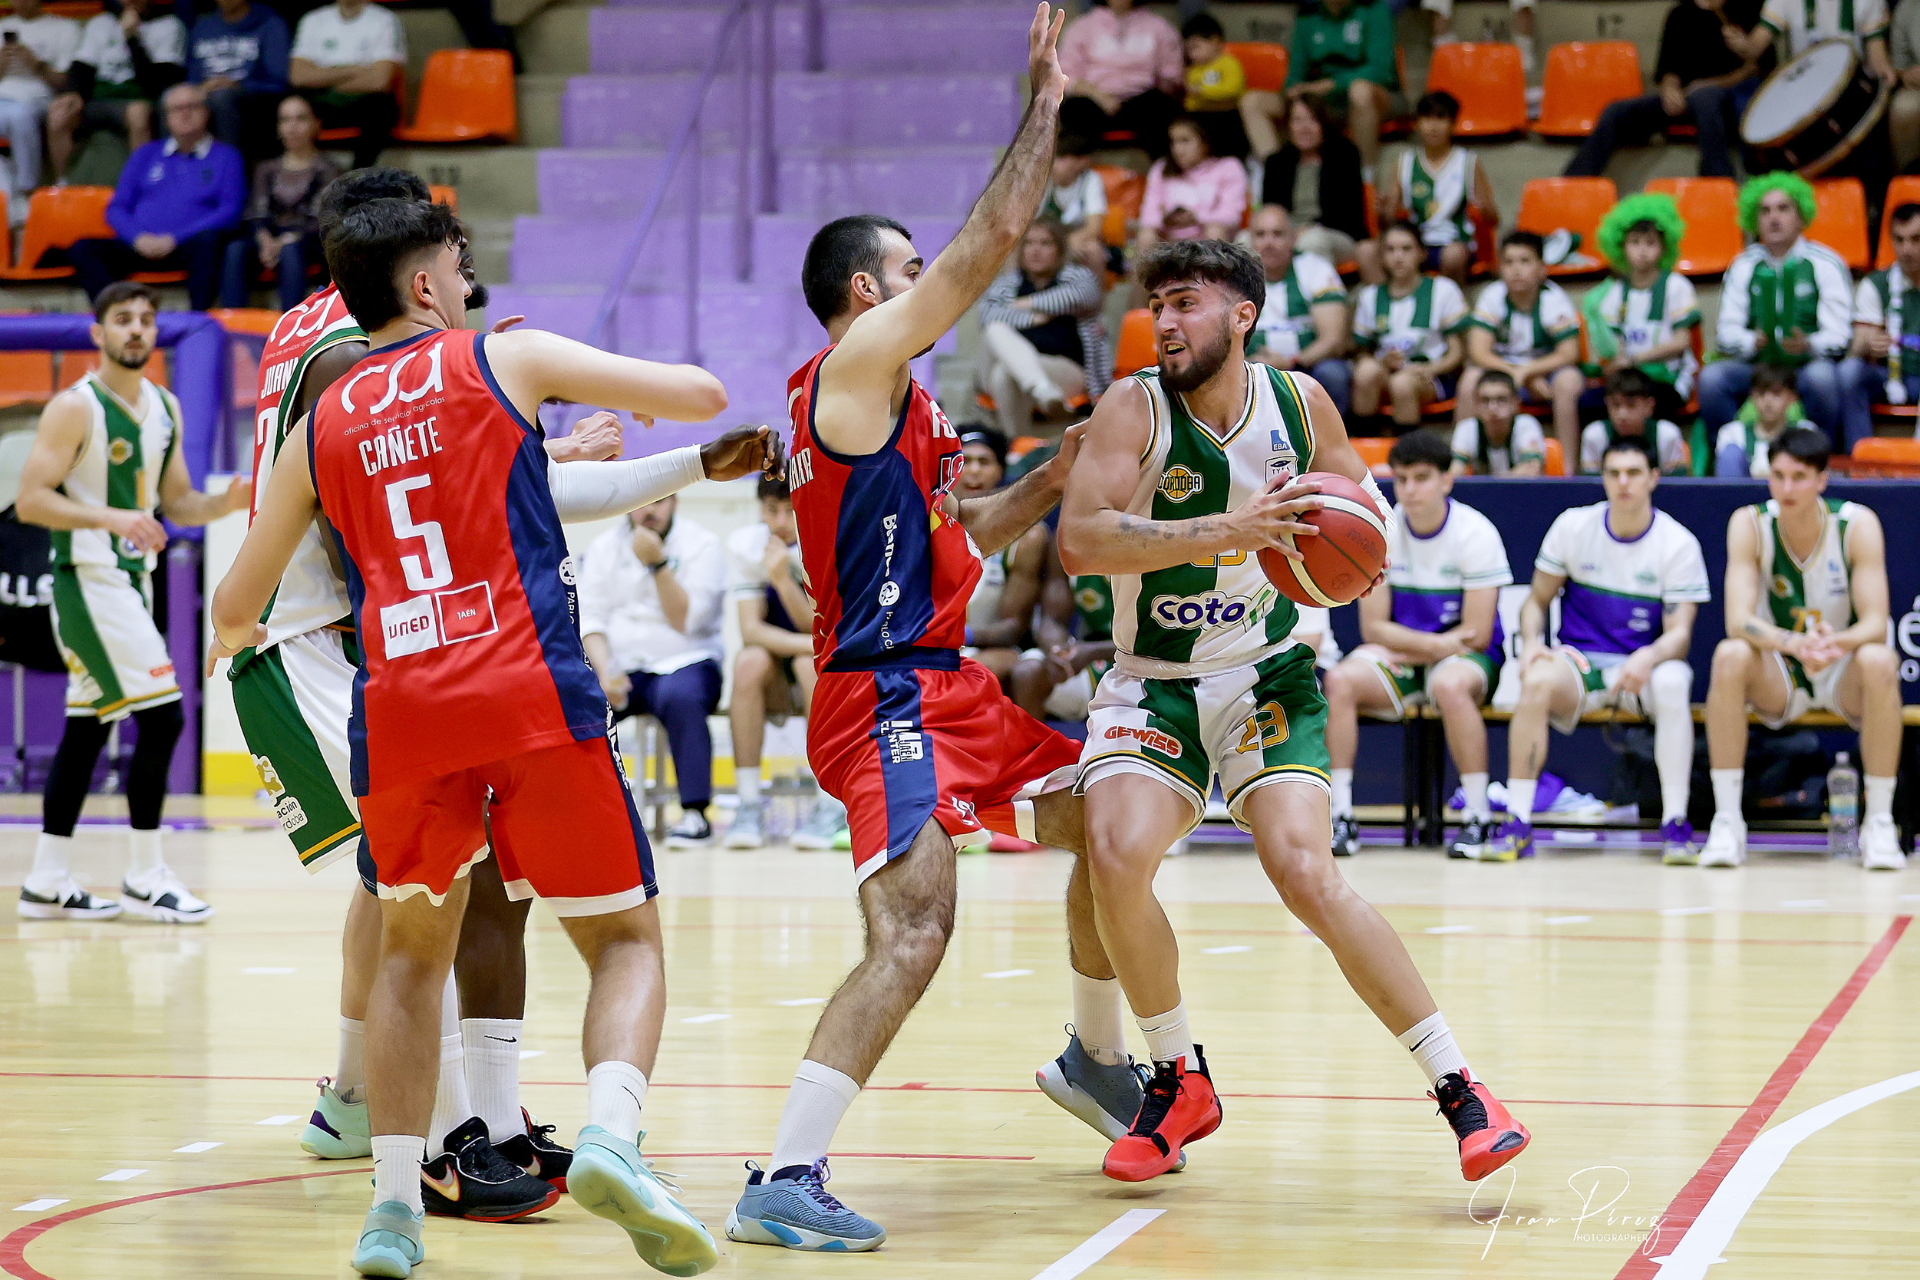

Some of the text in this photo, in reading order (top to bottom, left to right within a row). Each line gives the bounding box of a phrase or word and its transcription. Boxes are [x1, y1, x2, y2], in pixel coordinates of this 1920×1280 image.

[371, 418, 382, 427] de
[358, 416, 443, 477] CAÑETE
[385, 473, 454, 592] 5
[388, 615, 430, 639] UNED
[1235, 700, 1290, 755] 23
[276, 801, 298, 818] ación
